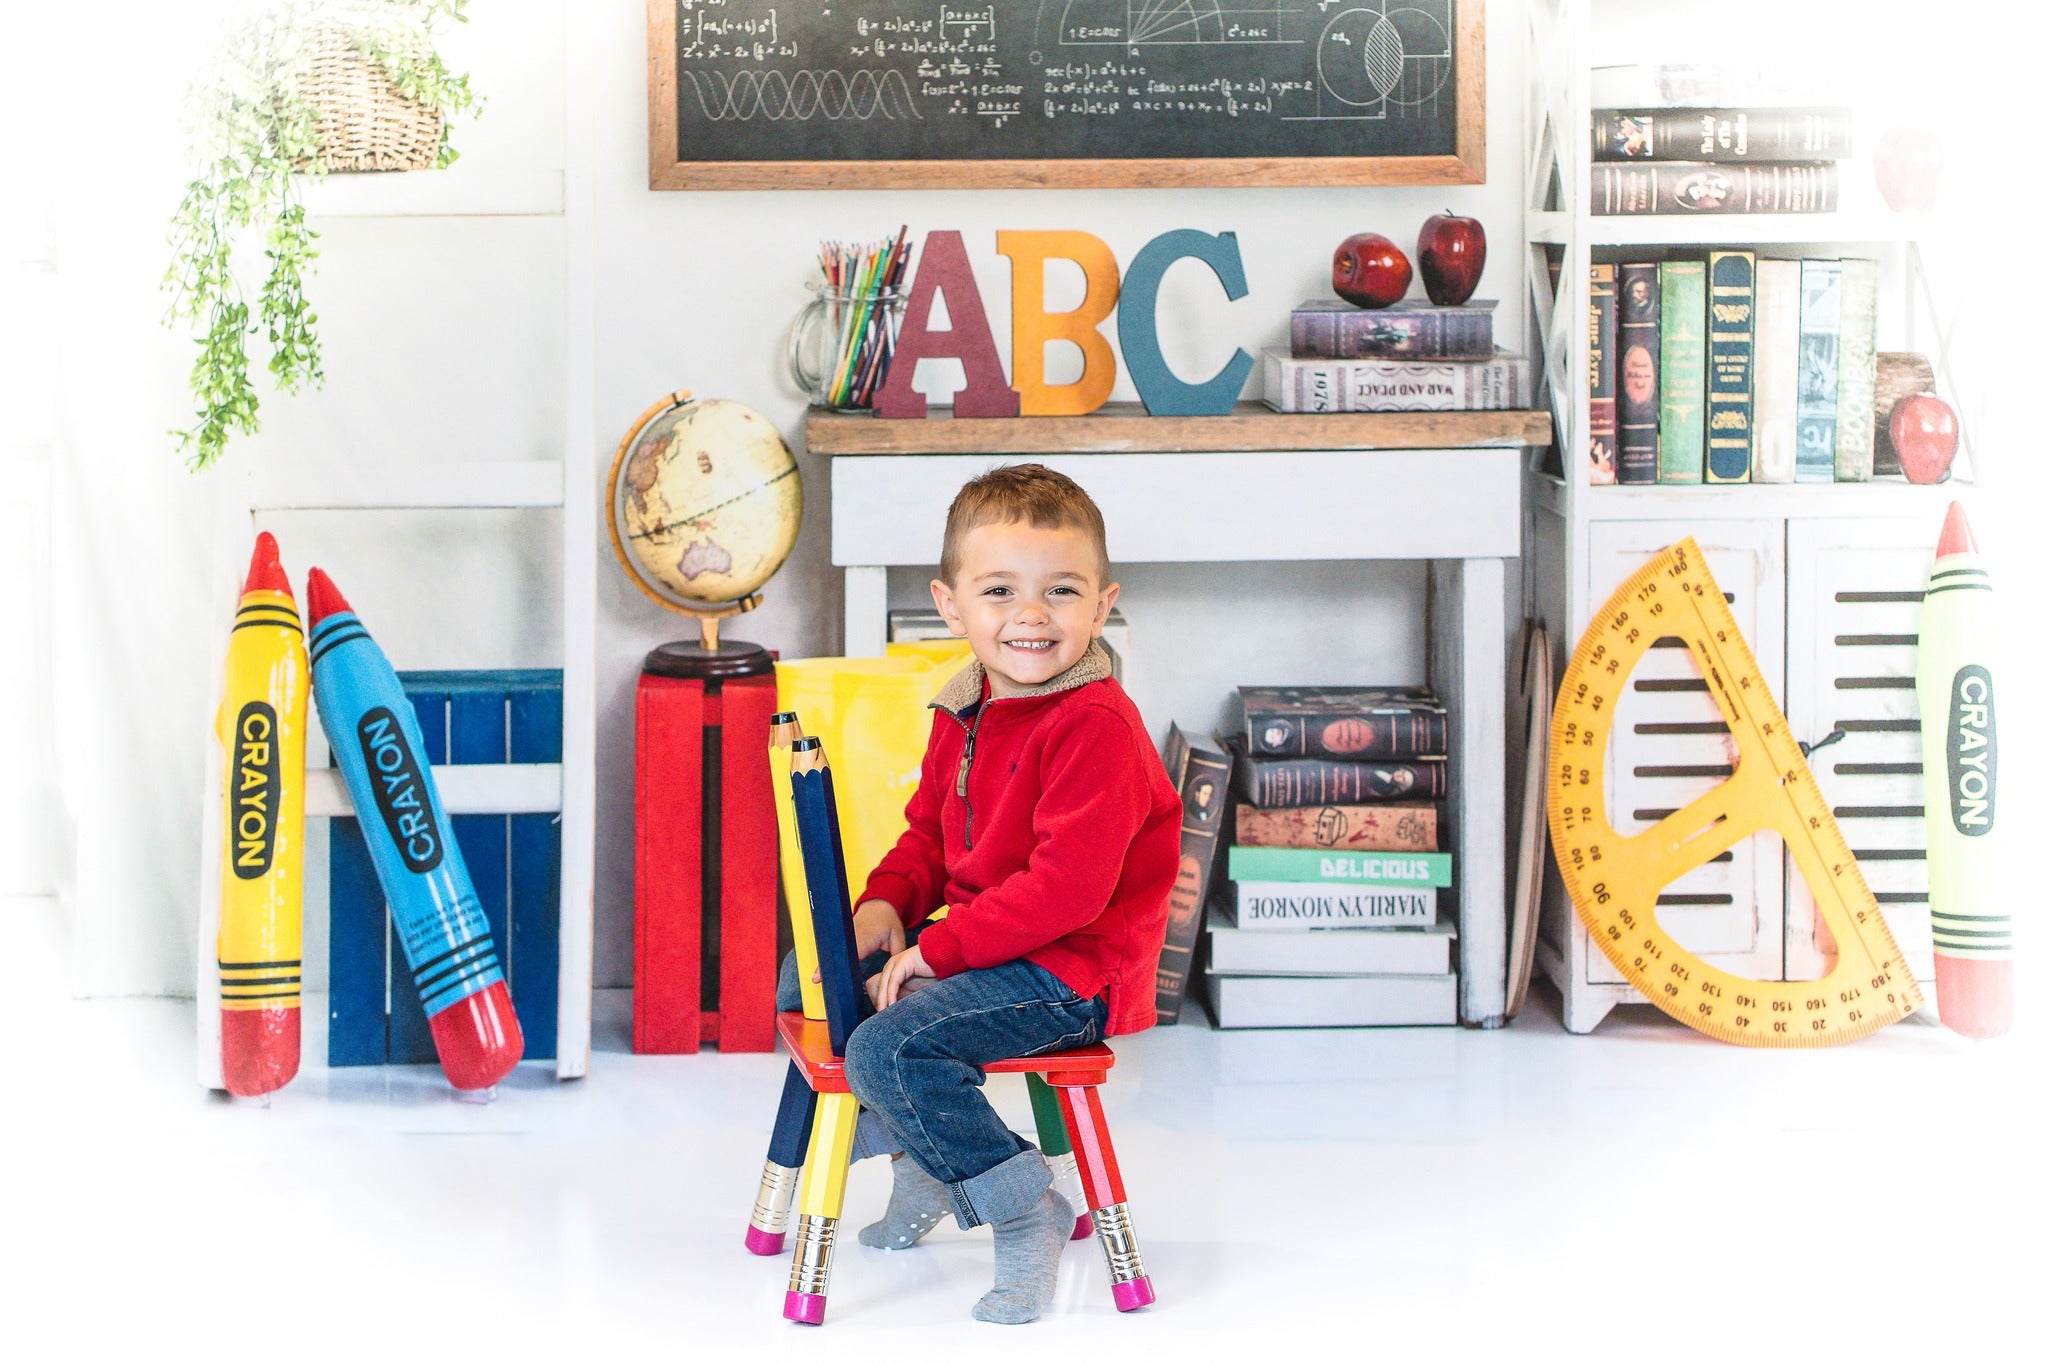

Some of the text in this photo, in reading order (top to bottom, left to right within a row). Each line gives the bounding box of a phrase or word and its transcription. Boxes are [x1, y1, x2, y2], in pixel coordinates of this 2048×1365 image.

[1357, 384, 1453, 397] WAR AND PEACE
[1669, 562, 1687, 577] 180
[1638, 583, 1656, 601] 170
[1683, 583, 1690, 592] 0
[1650, 603, 1663, 616] 10
[1612, 612, 1628, 631] 160
[1626, 628, 1639, 644] 20
[1590, 645, 1606, 666] 150
[1606, 659, 1619, 675] 30
[1575, 683, 1588, 704] 140
[1592, 696, 1603, 711] 40
[1565, 723, 1577, 744] 130
[1583, 731, 1593, 746] 50
[1960, 676, 1988, 825] CRAYON
[1562, 765, 1572, 786] 120
[1580, 769, 1589, 784] 60
[238, 713, 270, 868] CRAYON
[364, 719, 435, 862] CRAYON
[1564, 807, 1574, 829] 110
[1582, 807, 1591, 822] 70
[1810, 817, 1820, 829] 20
[1572, 848, 1584, 870] 100
[1590, 846, 1601, 861] 80
[1320, 858, 1430, 880] DELICIOUS
[1593, 883, 1610, 904] 90
[1249, 895, 1427, 919] MARILYN MONROE
[1620, 909, 1636, 930] 100
[1856, 911, 1866, 923] 10
[1608, 926, 1621, 940] 80
[1644, 940, 1662, 959] 110
[1634, 957, 1647, 972] 70
[1671, 963, 1689, 980] 120
[1872, 972, 1891, 989] 180
[1664, 983, 1678, 996] 60
[1702, 982, 1720, 997] 130
[1841, 988, 1860, 1003] 170
[1737, 995, 1756, 1008] 140
[1807, 998, 1826, 1010] 160
[1888, 993, 1895, 1003] 0
[1699, 1003, 1712, 1015] 50
[1773, 1001, 1792, 1011] 150
[1736, 1016, 1750, 1027] 40
[1849, 1010, 1862, 1021] 10
[1774, 1022, 1787, 1032] 30
[1813, 1018, 1826, 1030] 20
